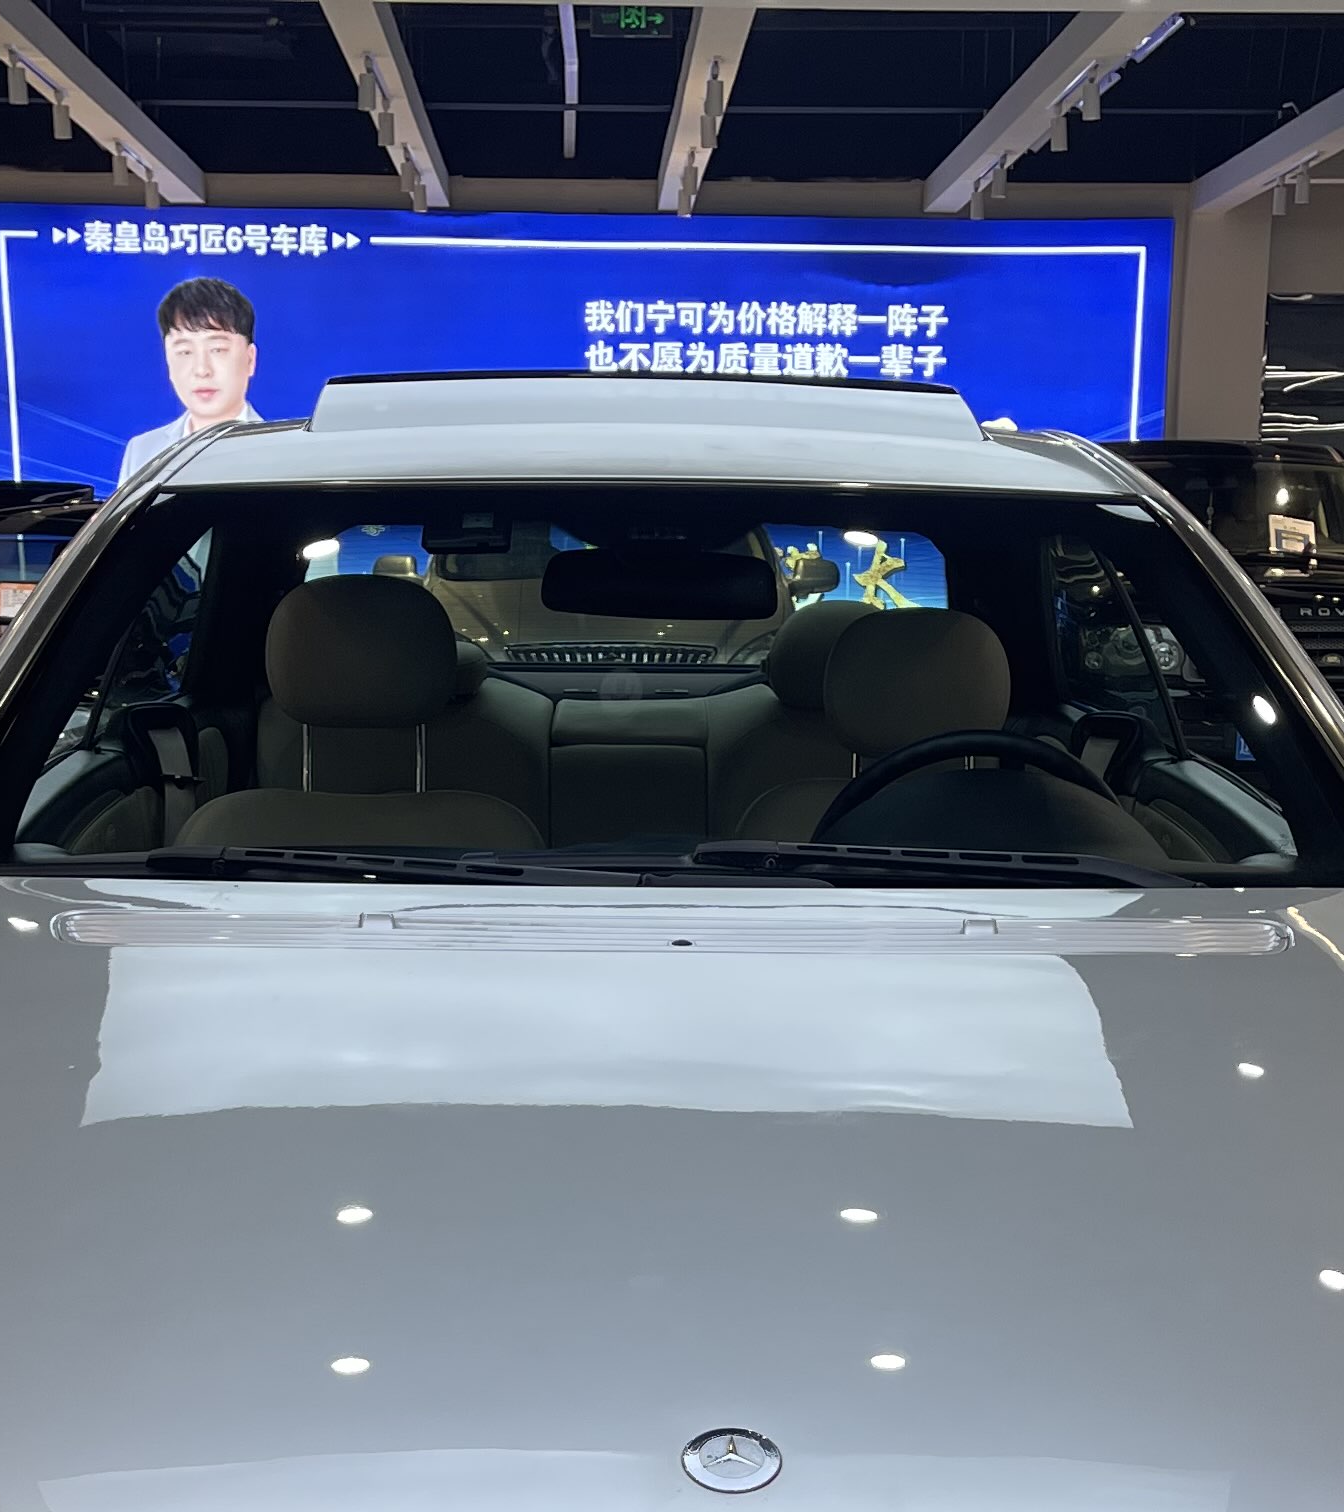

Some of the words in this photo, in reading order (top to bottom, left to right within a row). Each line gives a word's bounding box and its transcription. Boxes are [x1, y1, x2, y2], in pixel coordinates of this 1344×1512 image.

[83, 219, 329, 257] 秦皇岛巧匠6号车库
[584, 299, 949, 337] 我们宁可为价格解释一阵子
[584, 340, 947, 378] 也不愿为质量道歉一辈子
